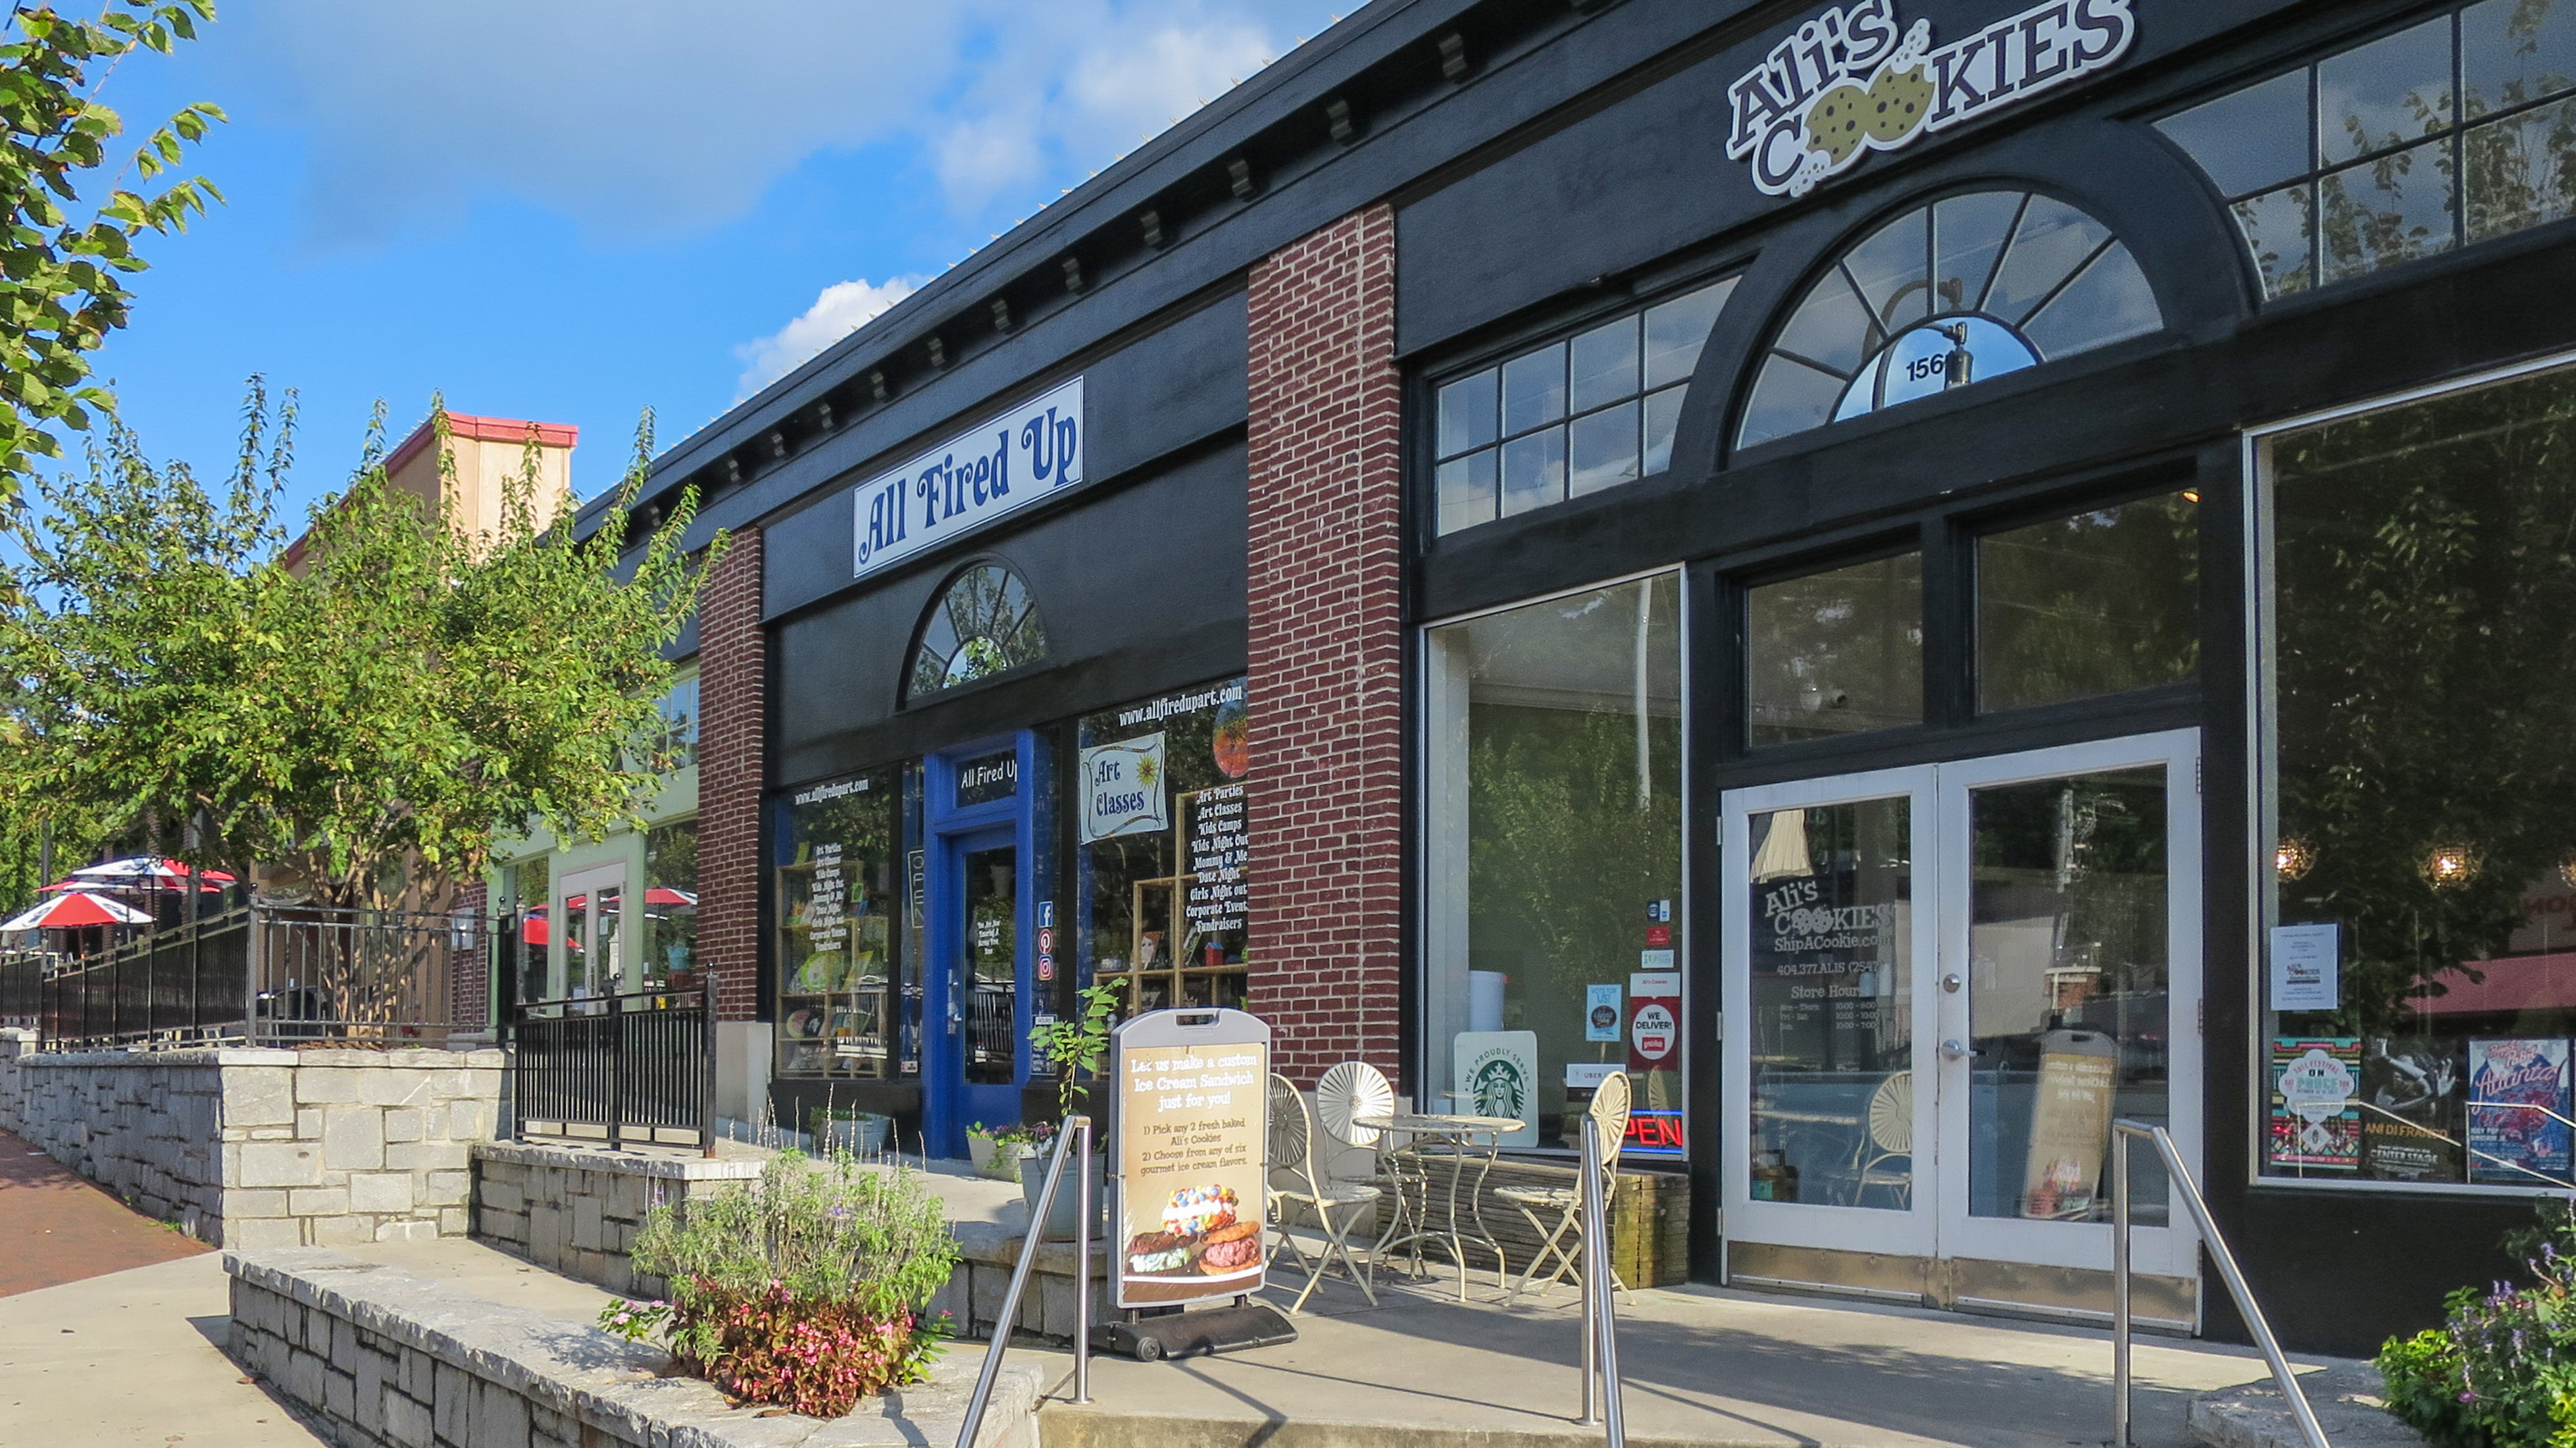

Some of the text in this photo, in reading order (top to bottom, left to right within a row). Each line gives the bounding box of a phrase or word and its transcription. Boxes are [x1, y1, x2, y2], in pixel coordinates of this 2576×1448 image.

[1730, 0, 1890, 150] Ali's
[1906, 354, 1945, 382] 156
[859, 405, 1077, 565] All Fired Up
[1119, 685, 1242, 727] www.allfiredupart.com
[961, 768, 974, 789] All
[977, 761, 1004, 785] Fired
[1095, 760, 1121, 787] Art
[1096, 790, 1144, 816] Classes
[1196, 784, 1244, 804] Art Parties
[1198, 802, 1242, 821] Art Classes
[1198, 818, 1242, 835] Kids Camps
[1191, 833, 1248, 853] Kids Night Out
[1193, 856, 1223, 871] Mommy
[1234, 849, 1248, 864] Me
[1197, 866, 1241, 884] Date Night
[1190, 887, 1209, 901] Girls
[1210, 883, 1233, 900] Night
[1765, 881, 1819, 918] Ali's
[1186, 902, 1223, 918] Corporate
[1195, 916, 1242, 933] Fundraisers
[1774, 933, 1890, 953] ShipACookie.com
[1791, 986, 1825, 998] Store
[1130, 1053, 1257, 1073] Let us make a custom
[1465, 1048, 1530, 1083] WE PROUDLY SERVE
[1134, 1070, 1254, 1093] Ice Cream Sandwich
[1157, 1090, 1232, 1113] just for you!
[1152, 1124, 1172, 1135] Pick
[1173, 1124, 1189, 1136] any
[1190, 1122, 1196, 1131] 2
[1198, 1120, 1221, 1131] fresh
[1221, 1117, 1246, 1129] baked
[1170, 1133, 1222, 1147] Ali's Cookies
[1142, 1143, 1247, 1162] 2) Choose from any of six
[1140, 1156, 1248, 1177] gourmet ice cream flavors.
